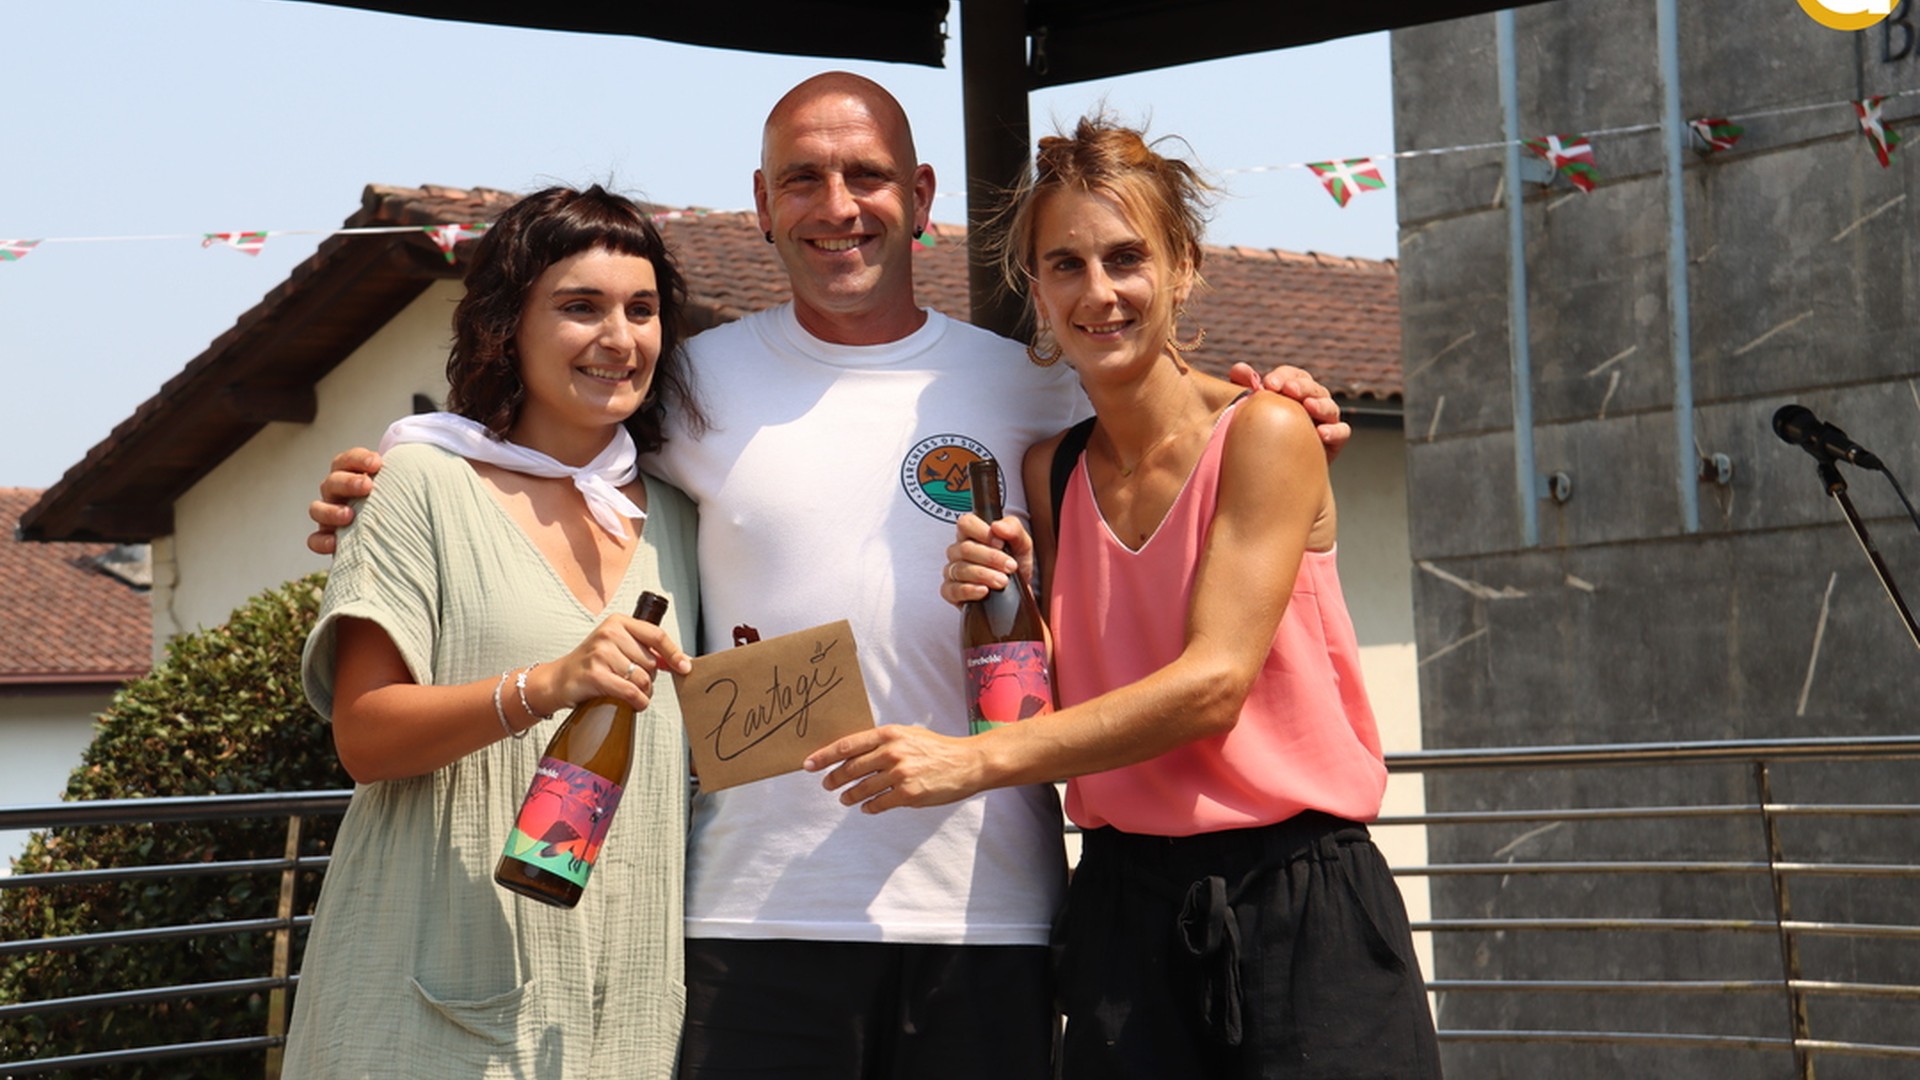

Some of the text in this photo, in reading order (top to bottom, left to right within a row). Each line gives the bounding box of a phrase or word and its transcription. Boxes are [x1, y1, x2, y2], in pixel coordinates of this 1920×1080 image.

[906, 437, 989, 494] SEARCHERS OF SURF
[921, 499, 967, 519] HIPPY
[705, 640, 843, 761] Zartagi
